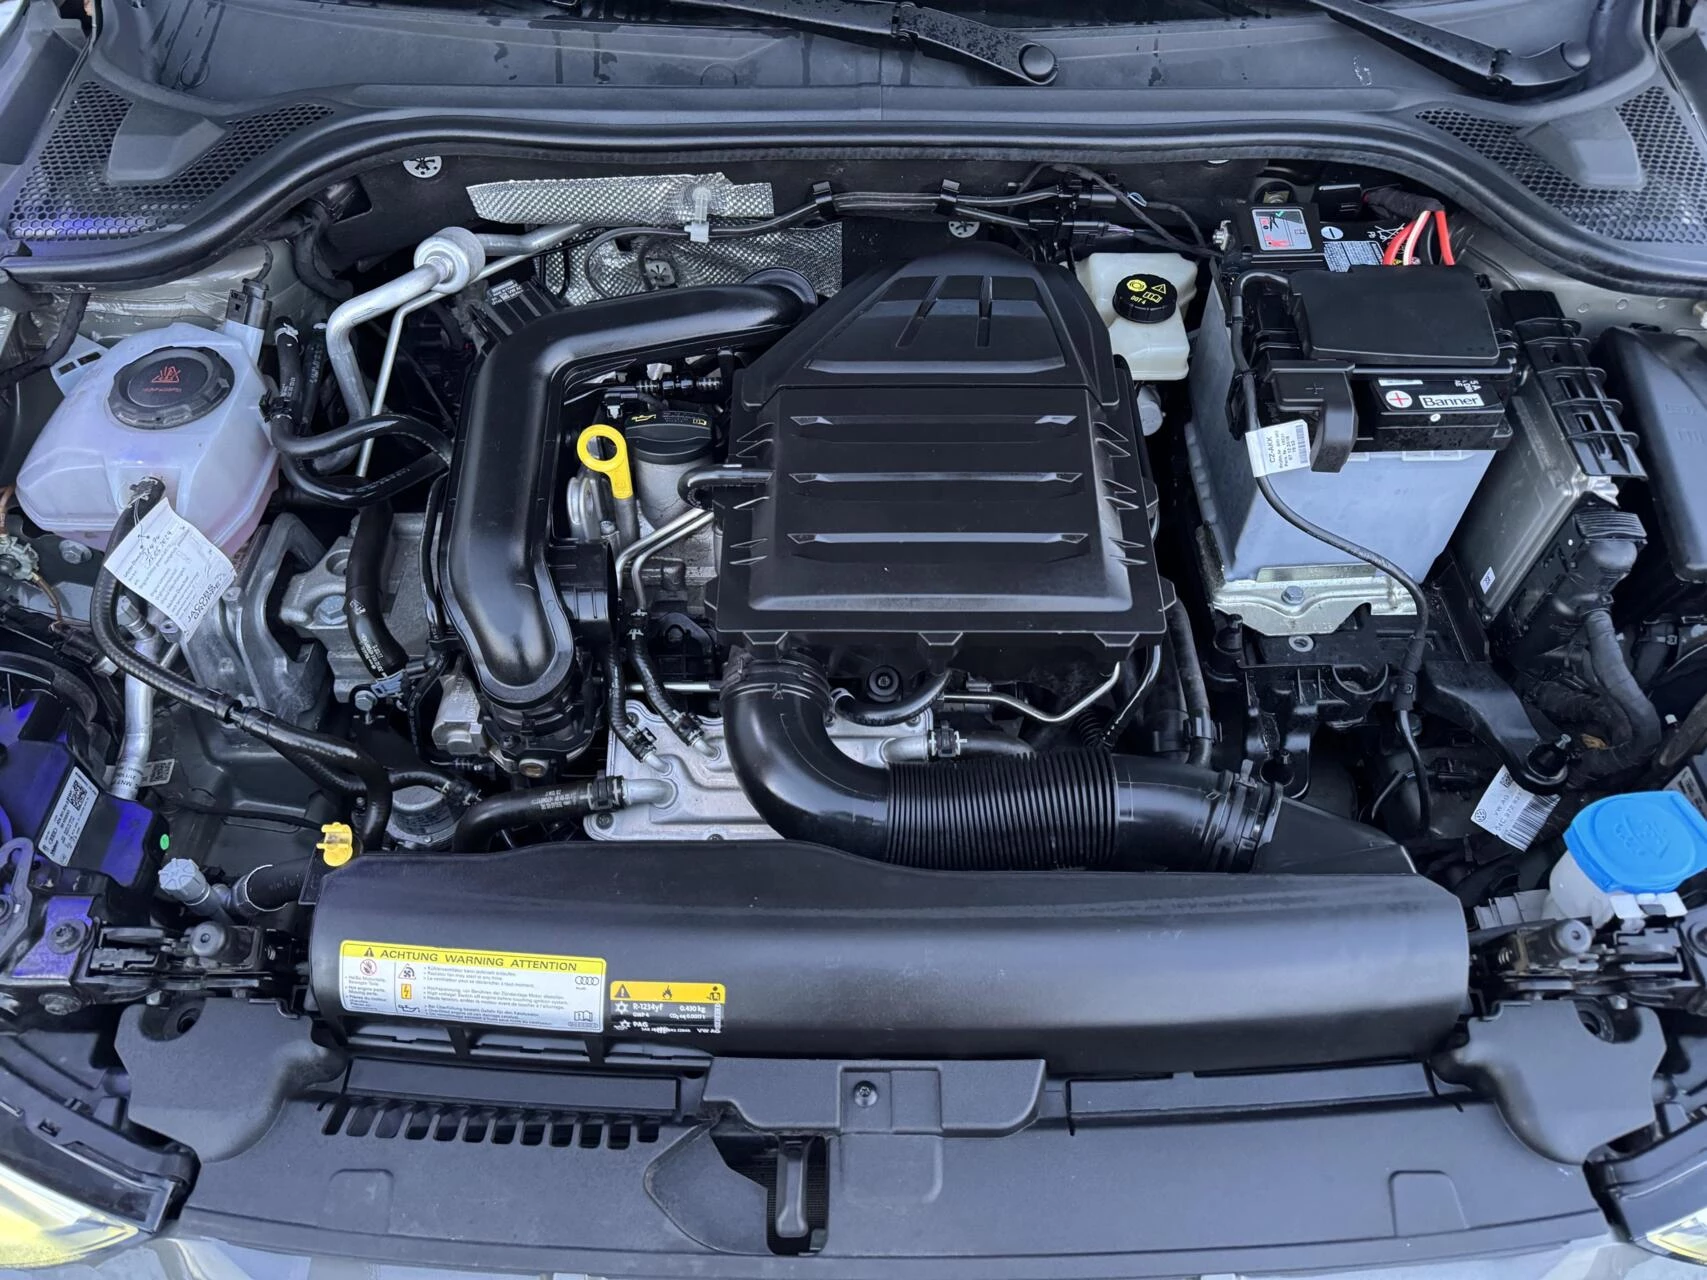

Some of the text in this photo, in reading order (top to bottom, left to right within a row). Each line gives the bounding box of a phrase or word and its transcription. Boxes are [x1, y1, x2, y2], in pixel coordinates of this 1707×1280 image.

[1423, 396, 1479, 407] Banner
[187, 583, 215, 622] JACOBS
[380, 950, 577, 971] ACHTUNG WARNING ATTENTION
[632, 1003, 664, 1012] R-1234yf
